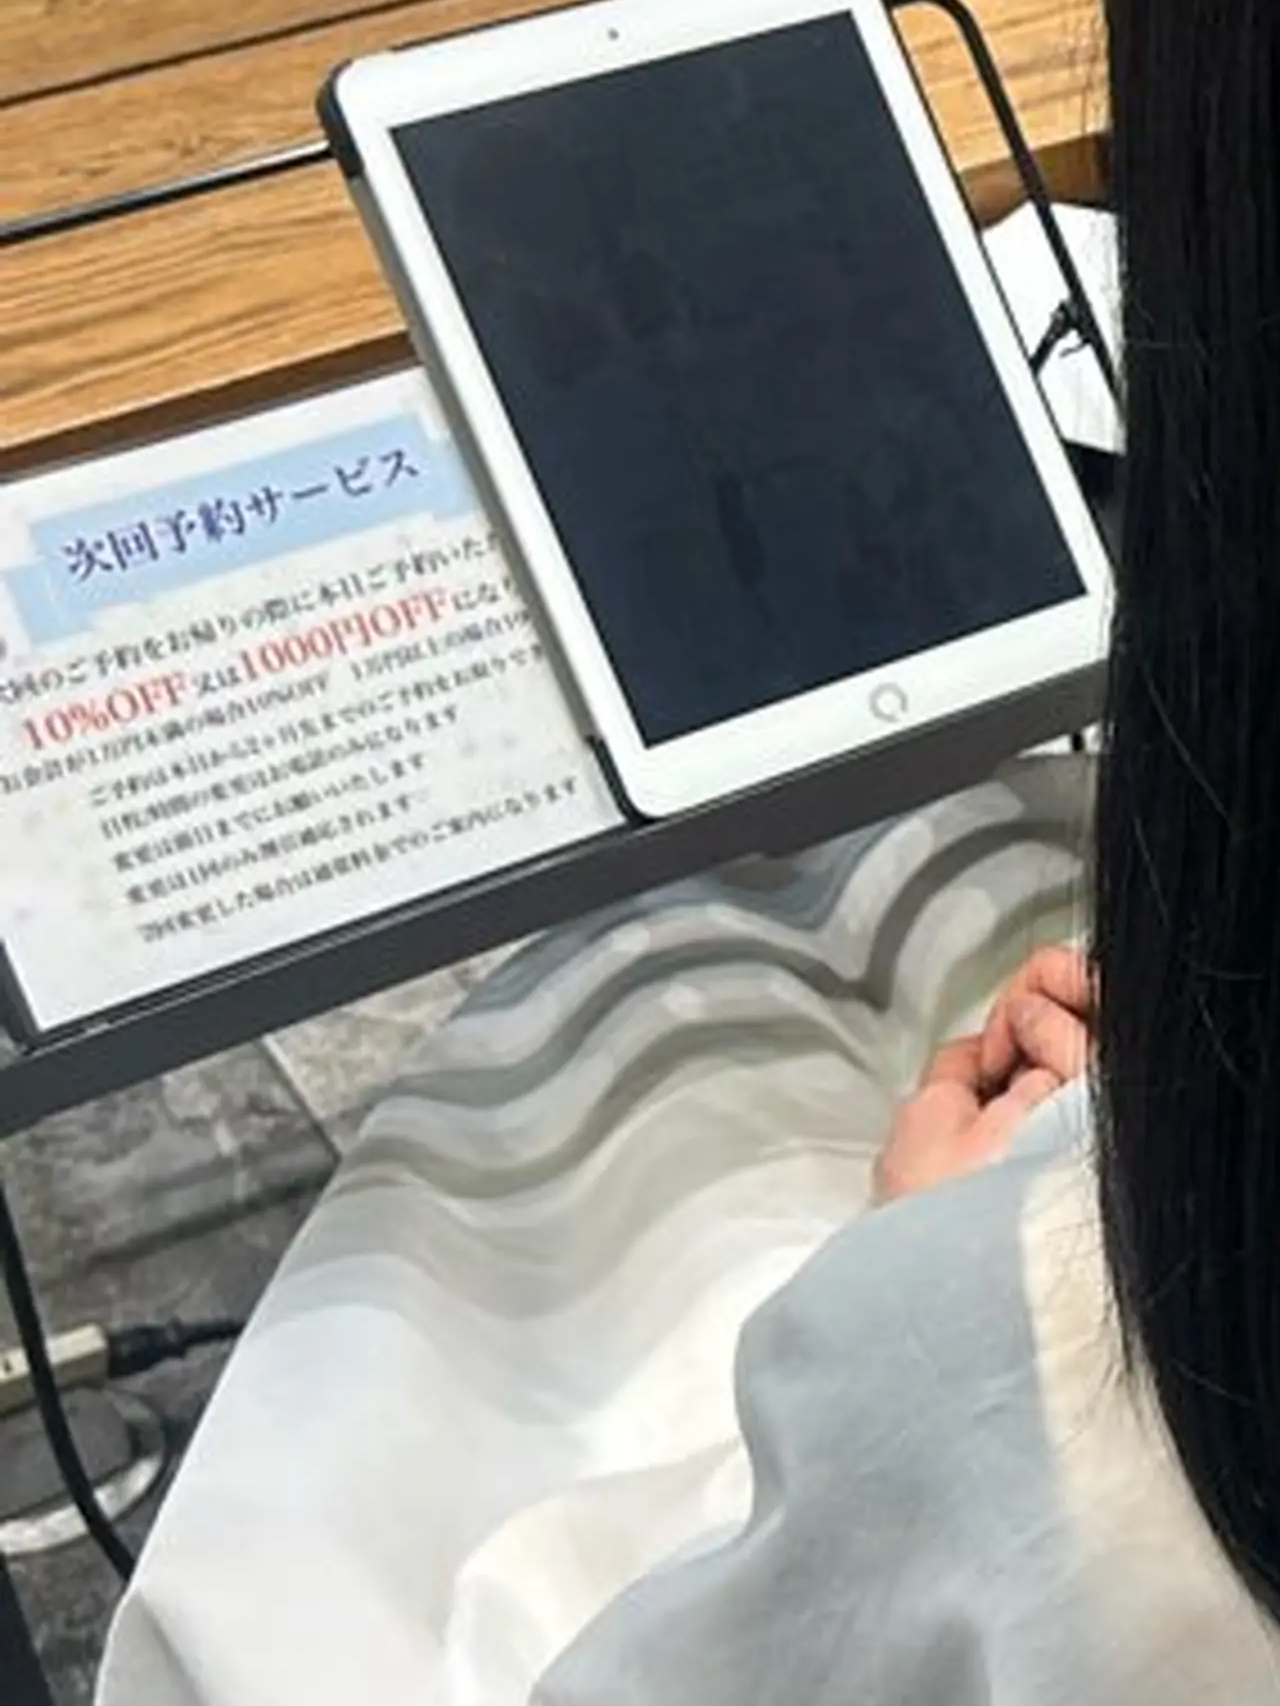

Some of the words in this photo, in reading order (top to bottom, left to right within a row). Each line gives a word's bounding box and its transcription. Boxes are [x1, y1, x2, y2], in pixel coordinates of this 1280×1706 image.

[65, 449, 419, 582] 次回予約サービス
